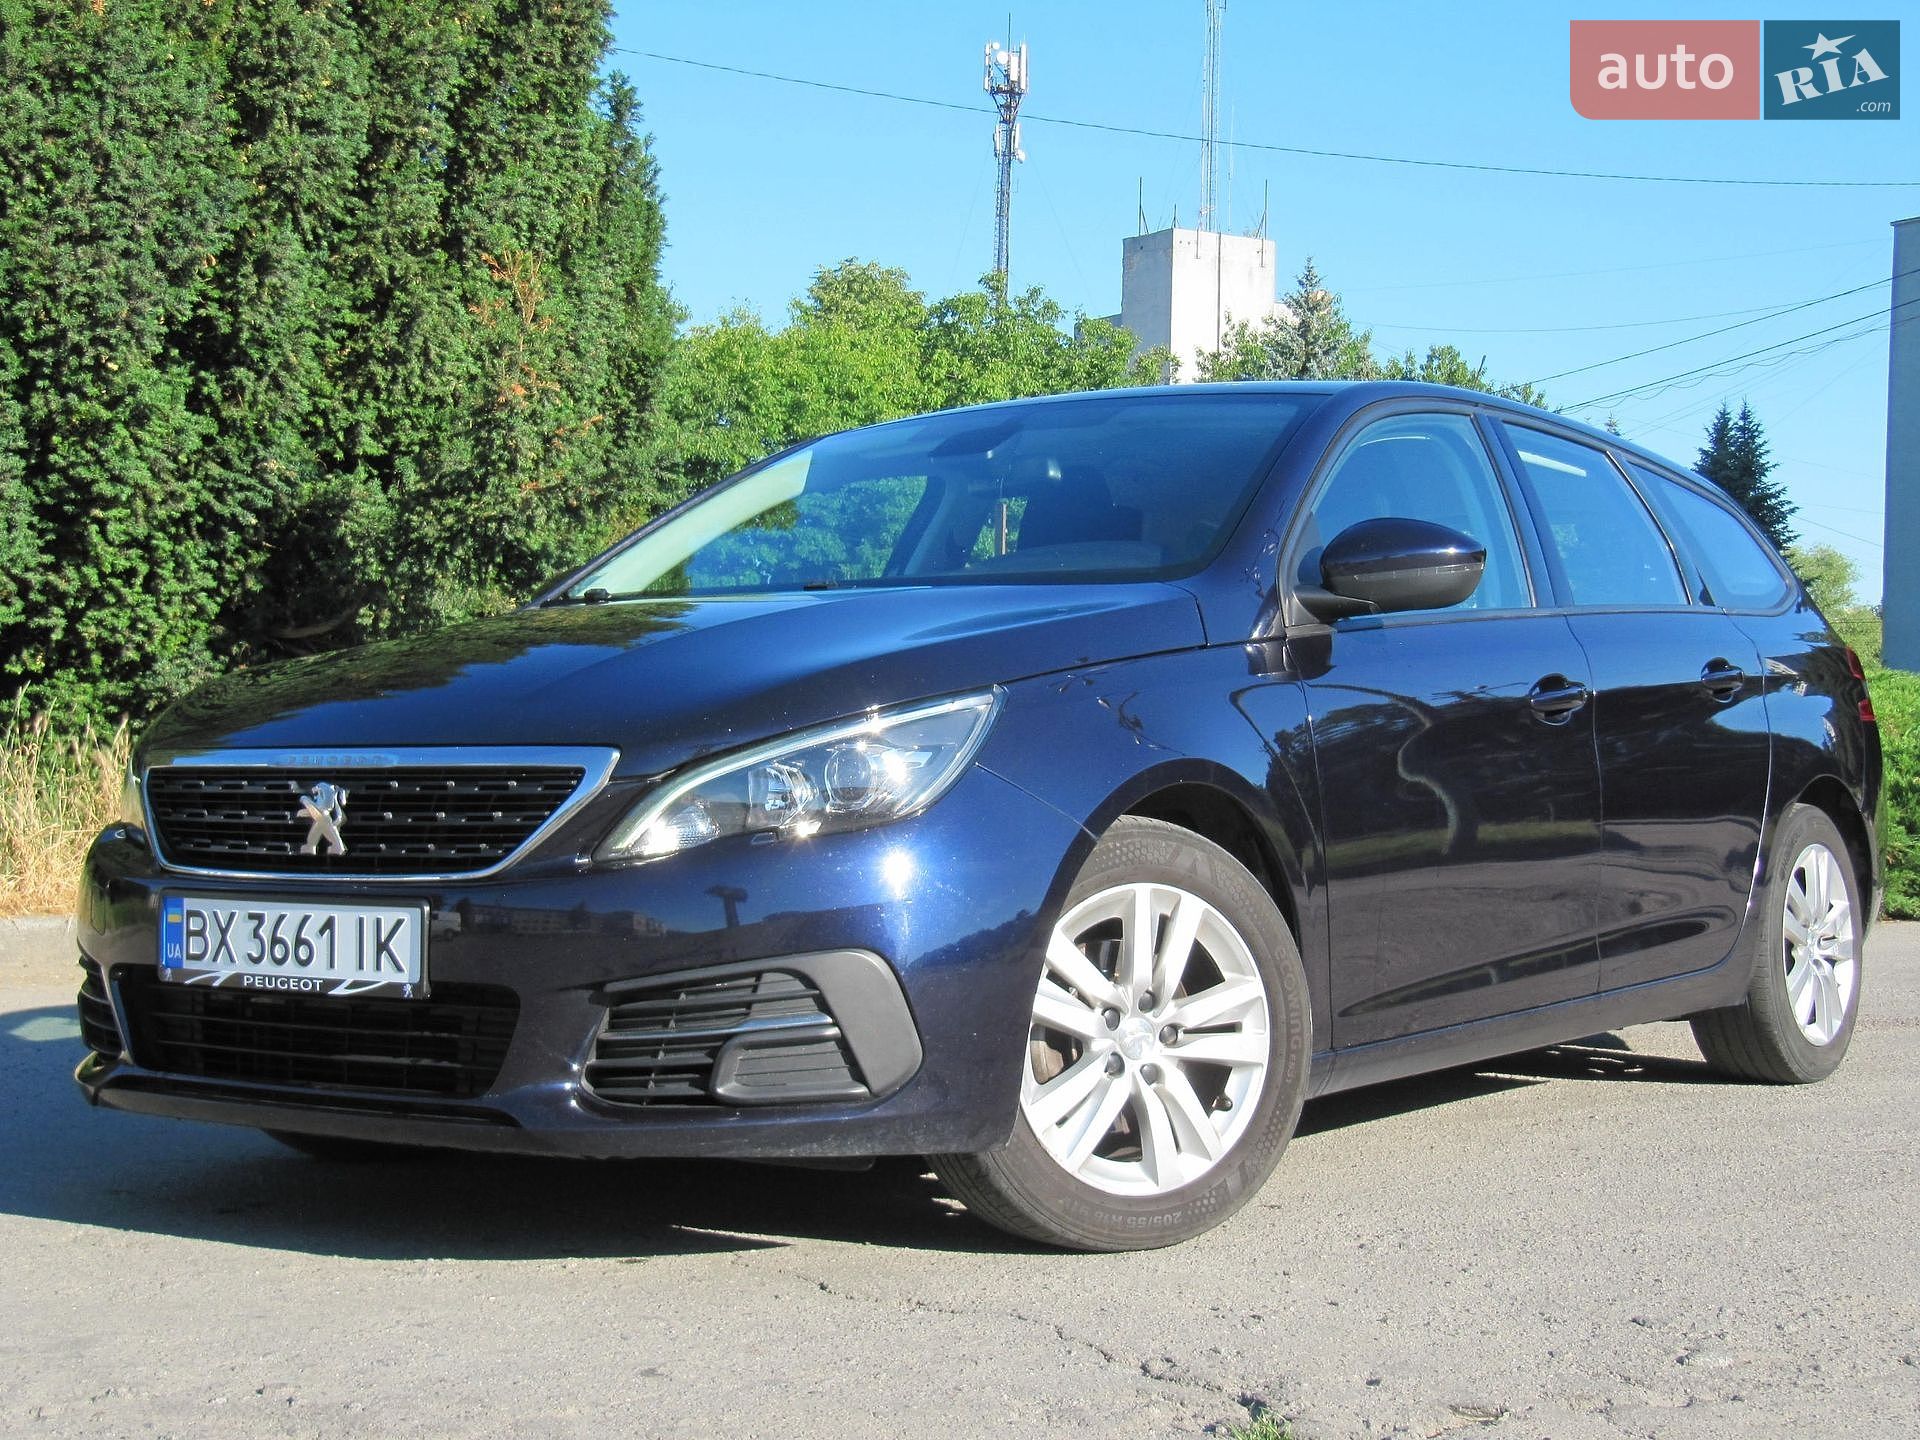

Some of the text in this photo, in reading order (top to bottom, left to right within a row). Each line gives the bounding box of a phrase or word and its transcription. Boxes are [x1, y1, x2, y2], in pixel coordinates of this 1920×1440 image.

[186, 909, 408, 973] BX 3661 IK
[167, 943, 182, 959] UA
[243, 975, 323, 992] PEUGEOT
[1126, 1209, 1183, 1225] 205/55
